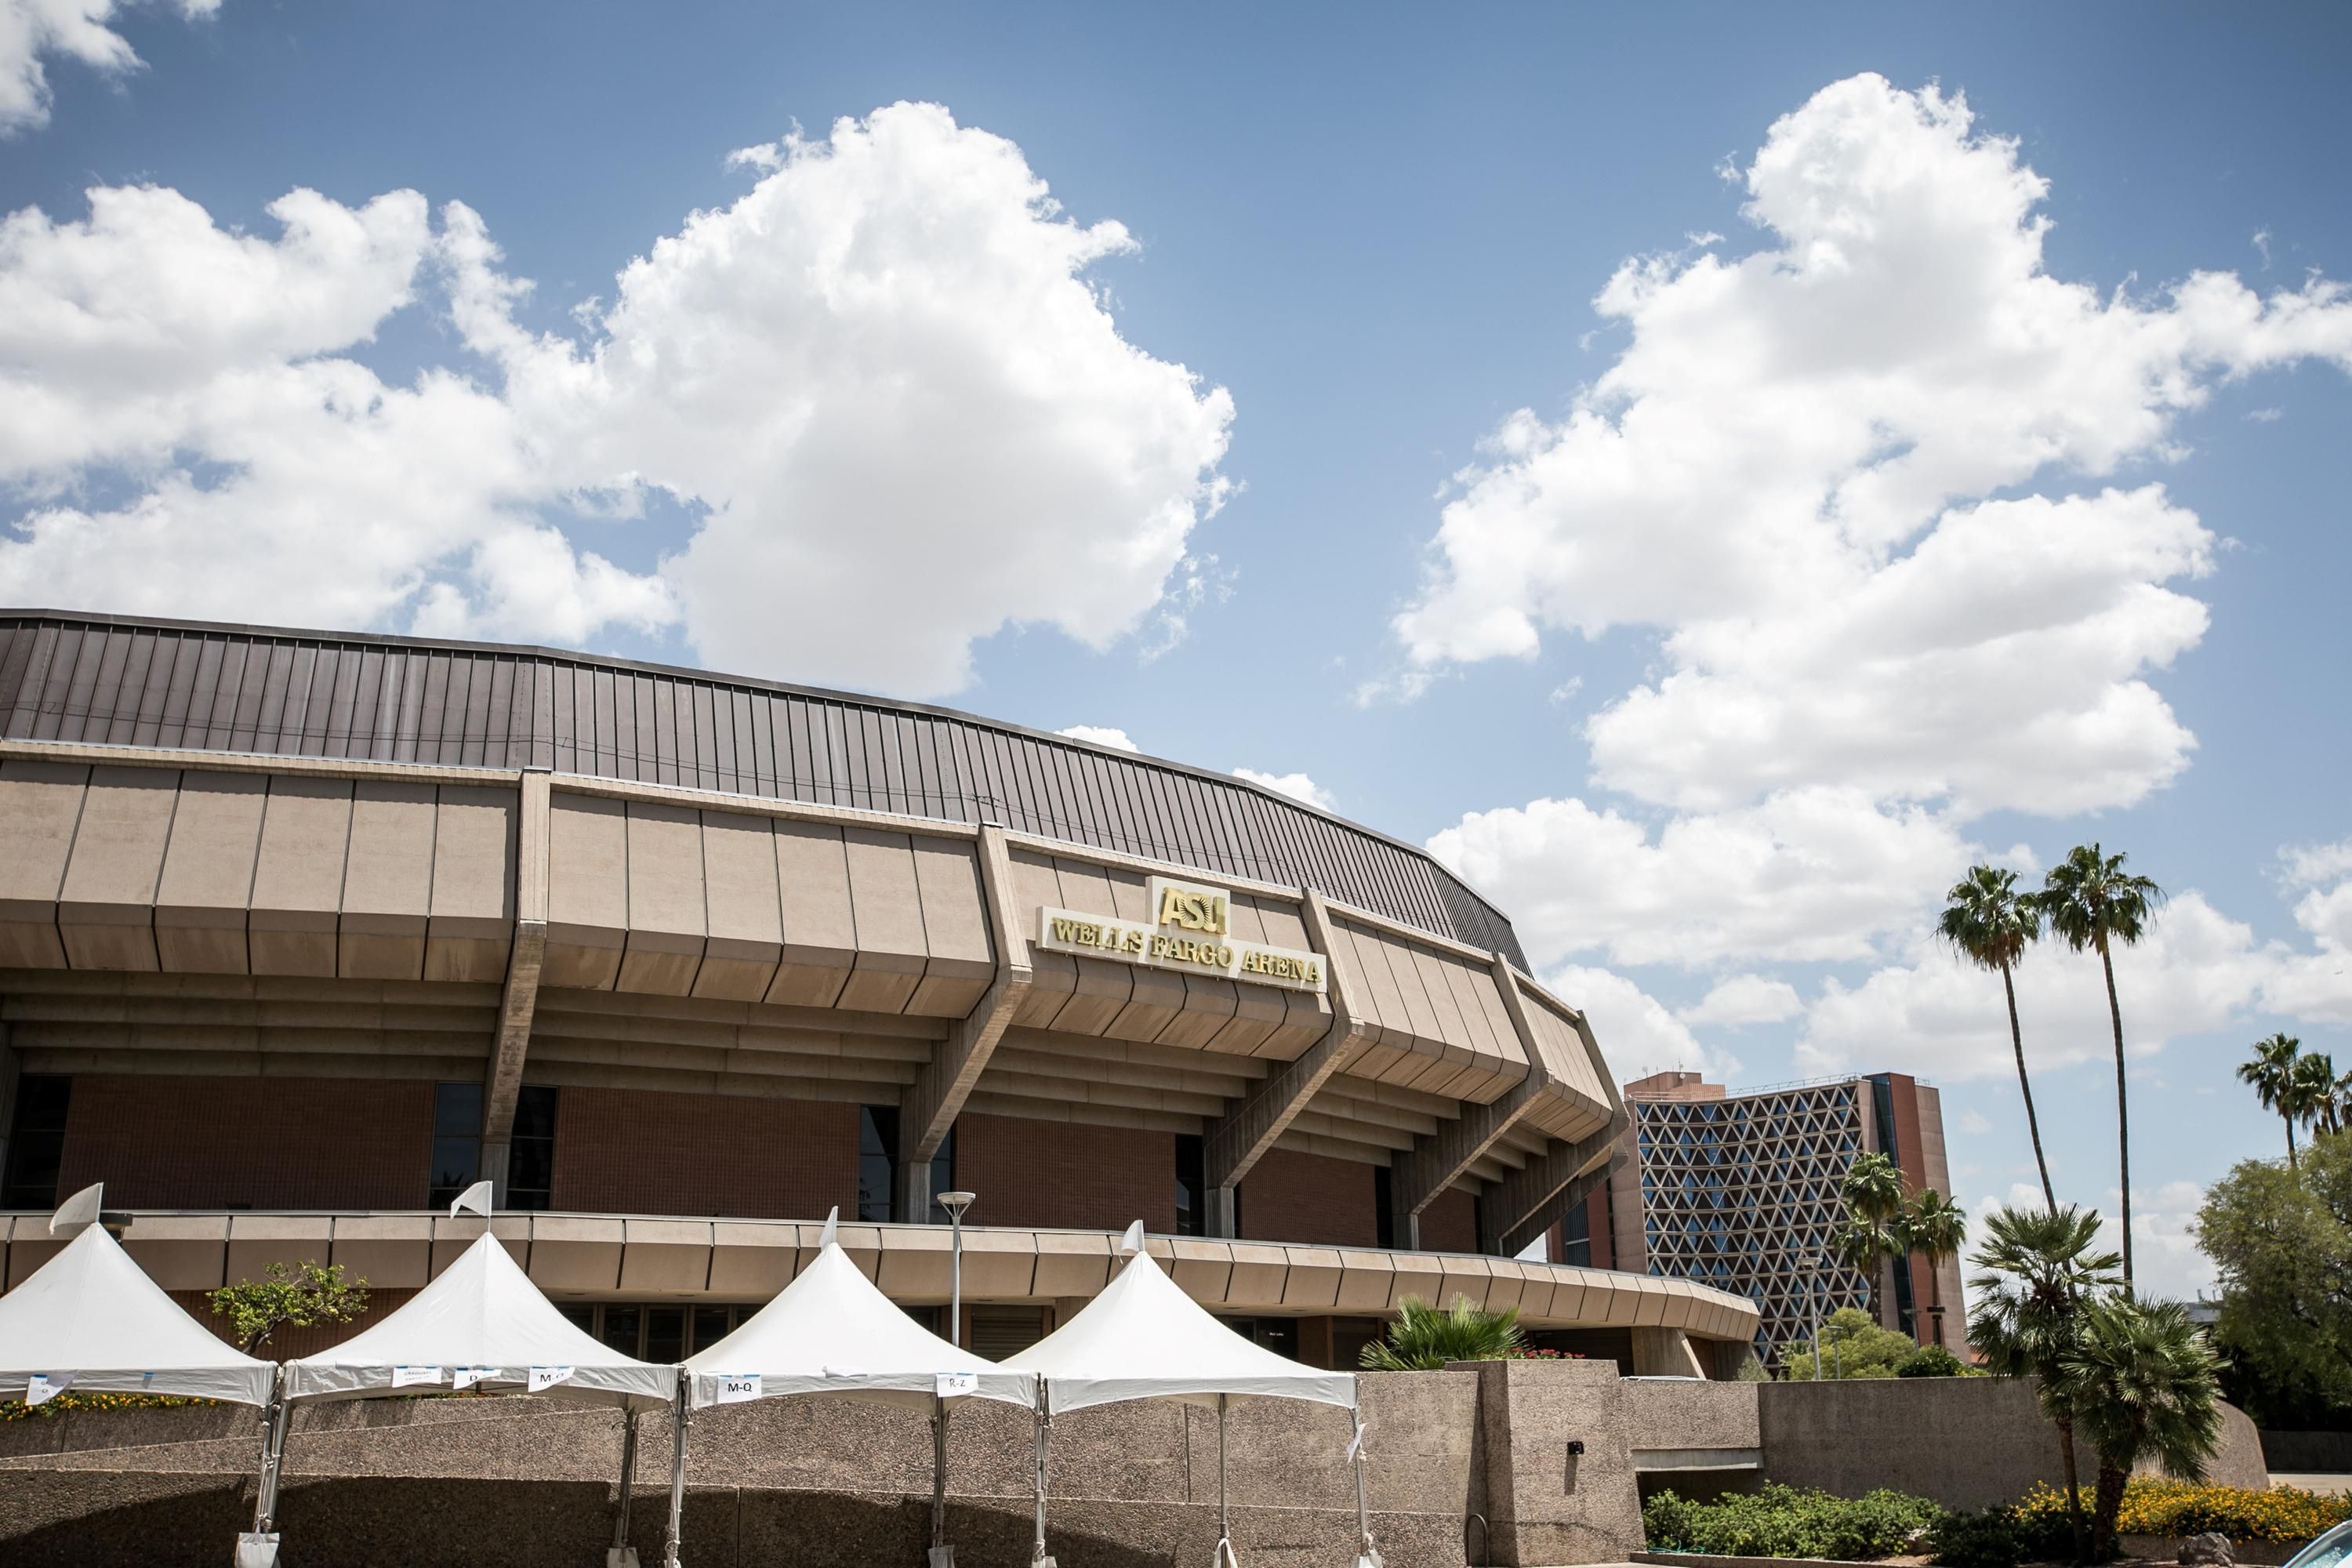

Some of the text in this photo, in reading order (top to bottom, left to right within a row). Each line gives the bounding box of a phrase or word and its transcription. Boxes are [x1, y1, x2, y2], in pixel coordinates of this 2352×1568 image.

[1160, 887, 1227, 935] ASU
[1052, 917, 1323, 983] WELLS FARGO ARENA
[728, 1382, 753, 1392] M-Q
[949, 1377, 966, 1388] R-Z
